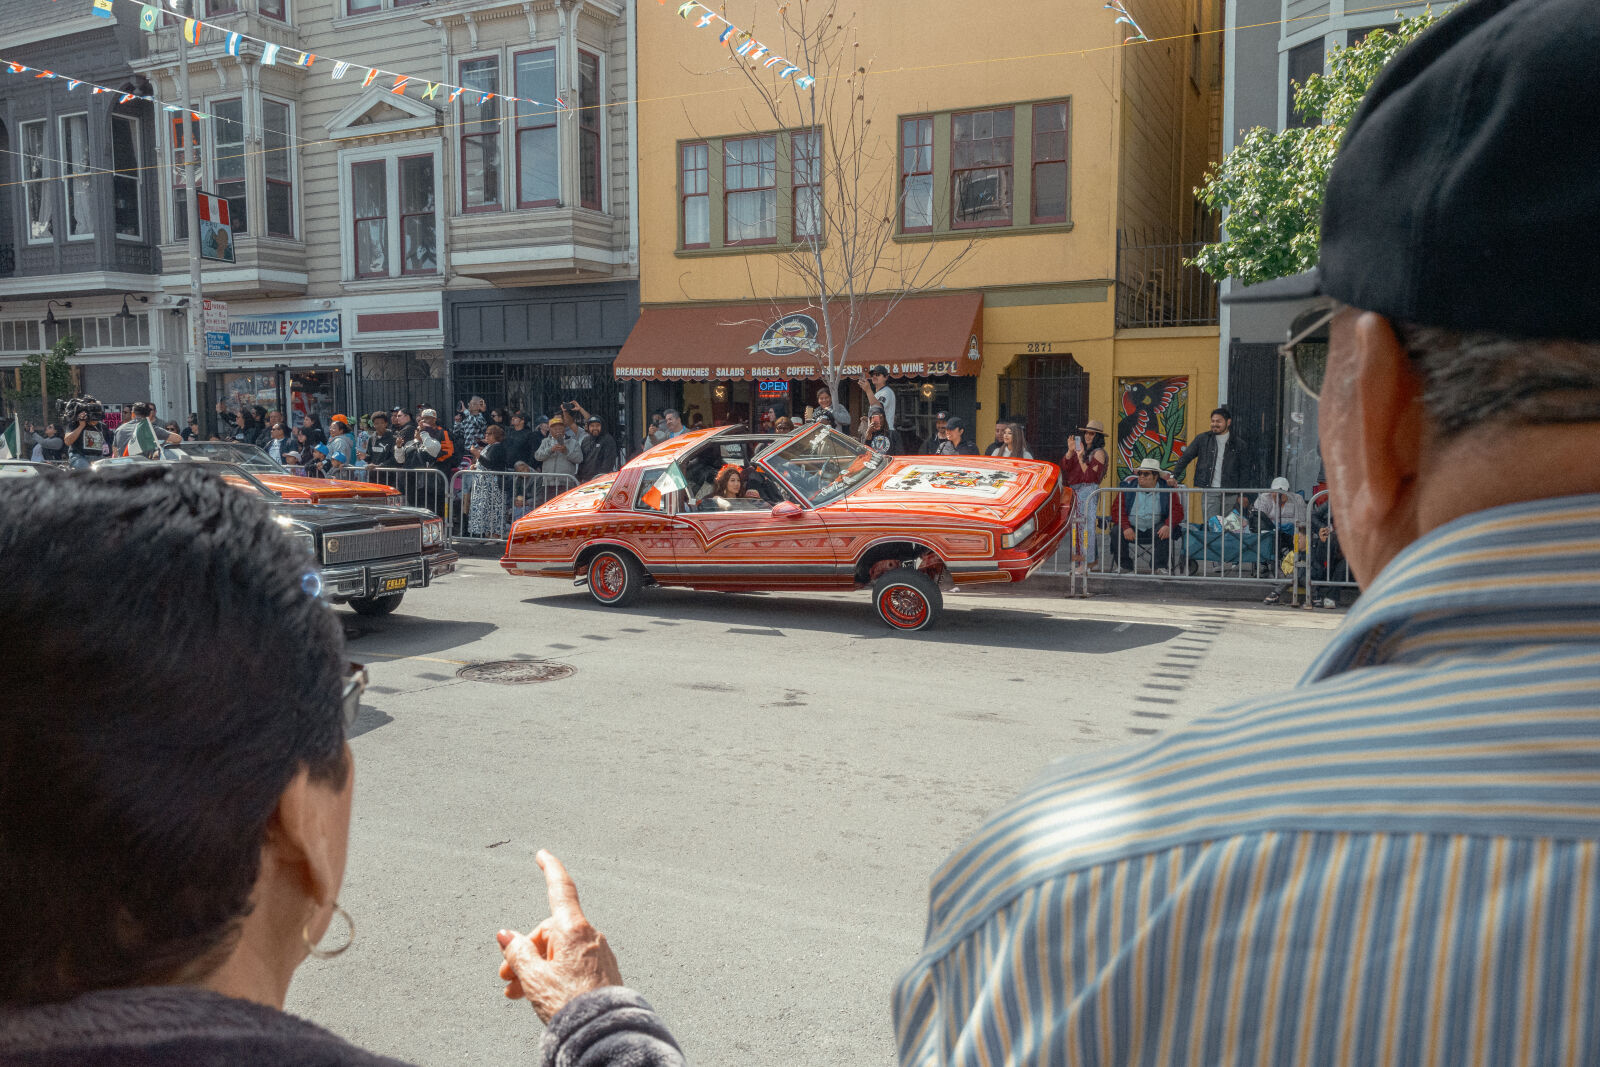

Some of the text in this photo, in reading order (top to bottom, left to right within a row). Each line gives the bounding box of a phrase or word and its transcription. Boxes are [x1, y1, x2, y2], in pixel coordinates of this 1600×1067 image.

[228, 318, 338, 341] ATEMALTECA EXPRESS
[1028, 342, 1052, 352] 2871
[616, 367, 655, 376] BREAKFAST
[662, 367, 709, 377] SANDWICHES
[716, 367, 744, 377] SALADS
[751, 367, 779, 376] BAGELS
[786, 366, 814, 375] COFFEE
[893, 363, 899, 373] &
[901, 362, 924, 373] WINE
[927, 361, 957, 374] 2871
[760, 381, 788, 391] OPEN
